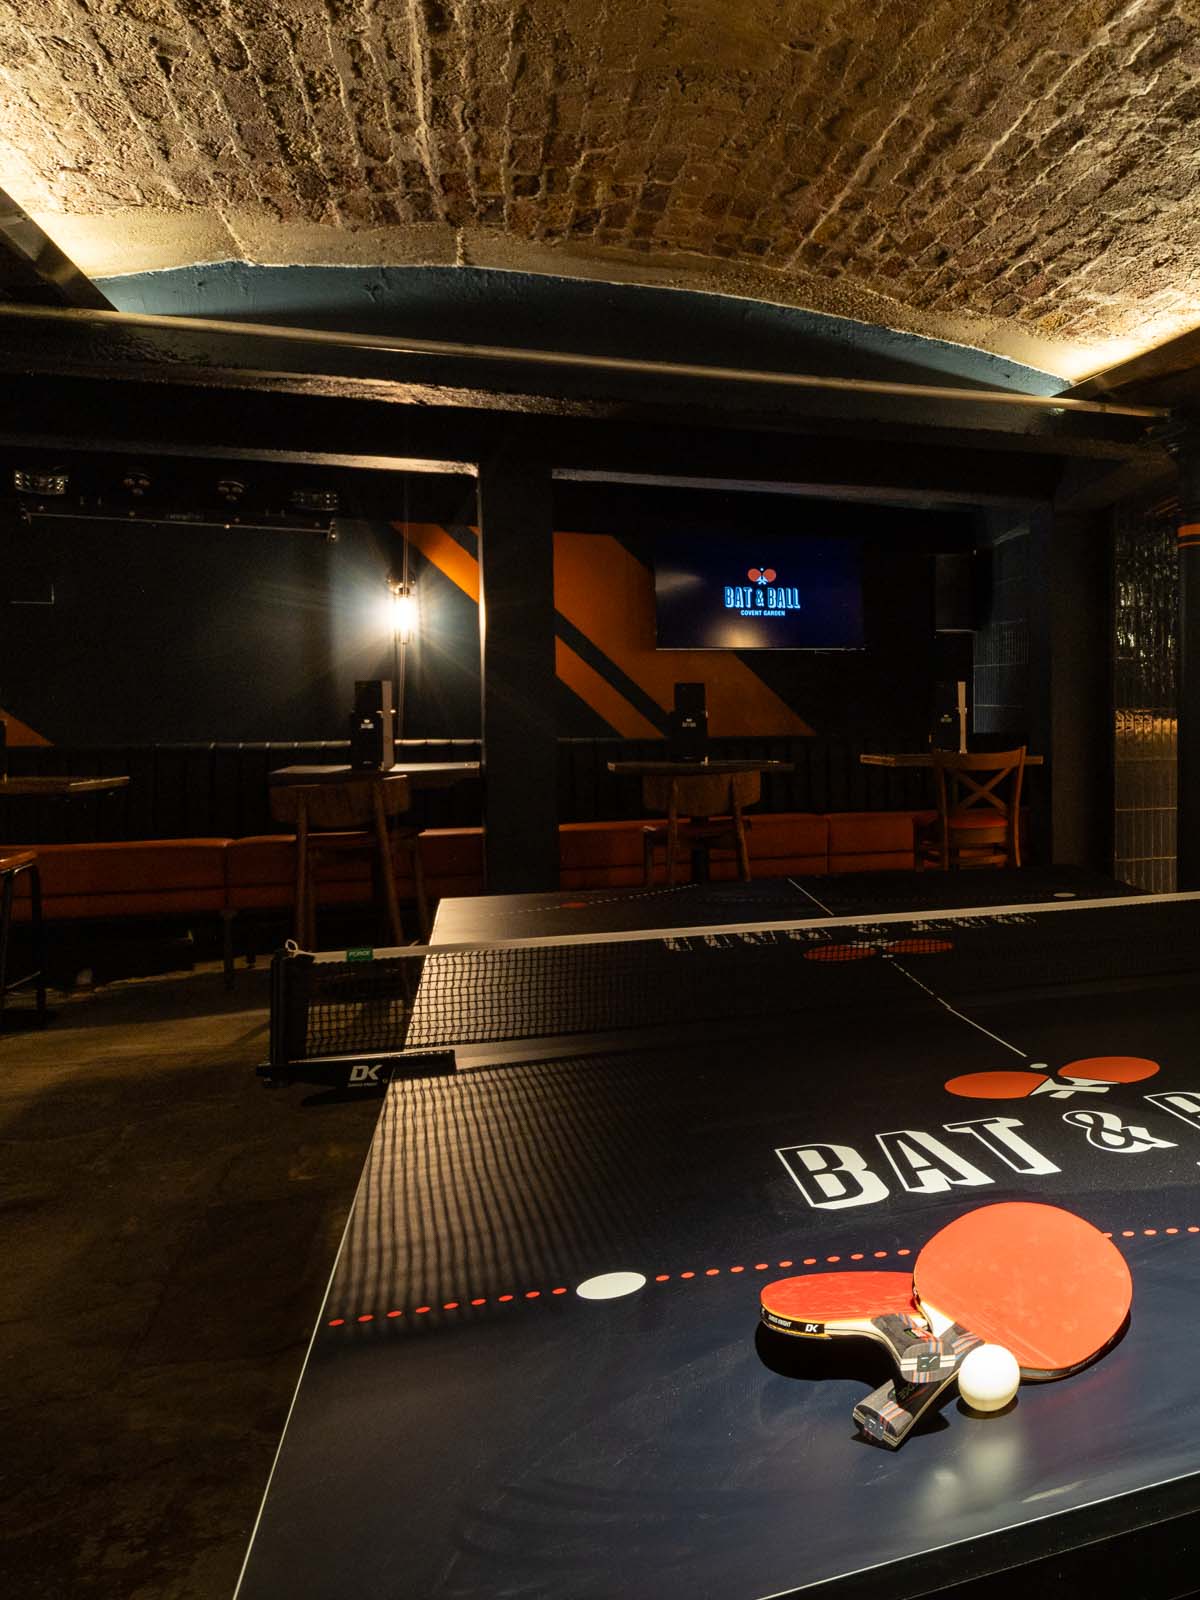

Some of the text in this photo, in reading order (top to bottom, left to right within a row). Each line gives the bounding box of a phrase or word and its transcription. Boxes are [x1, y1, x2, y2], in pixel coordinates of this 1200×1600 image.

[724, 586, 801, 609] BAT & BALL
[350, 1064, 383, 1081] DK
[775, 1117, 1062, 1210] BAT
[1062, 1110, 1178, 1153] &
[805, 1324, 818, 1332] DK
